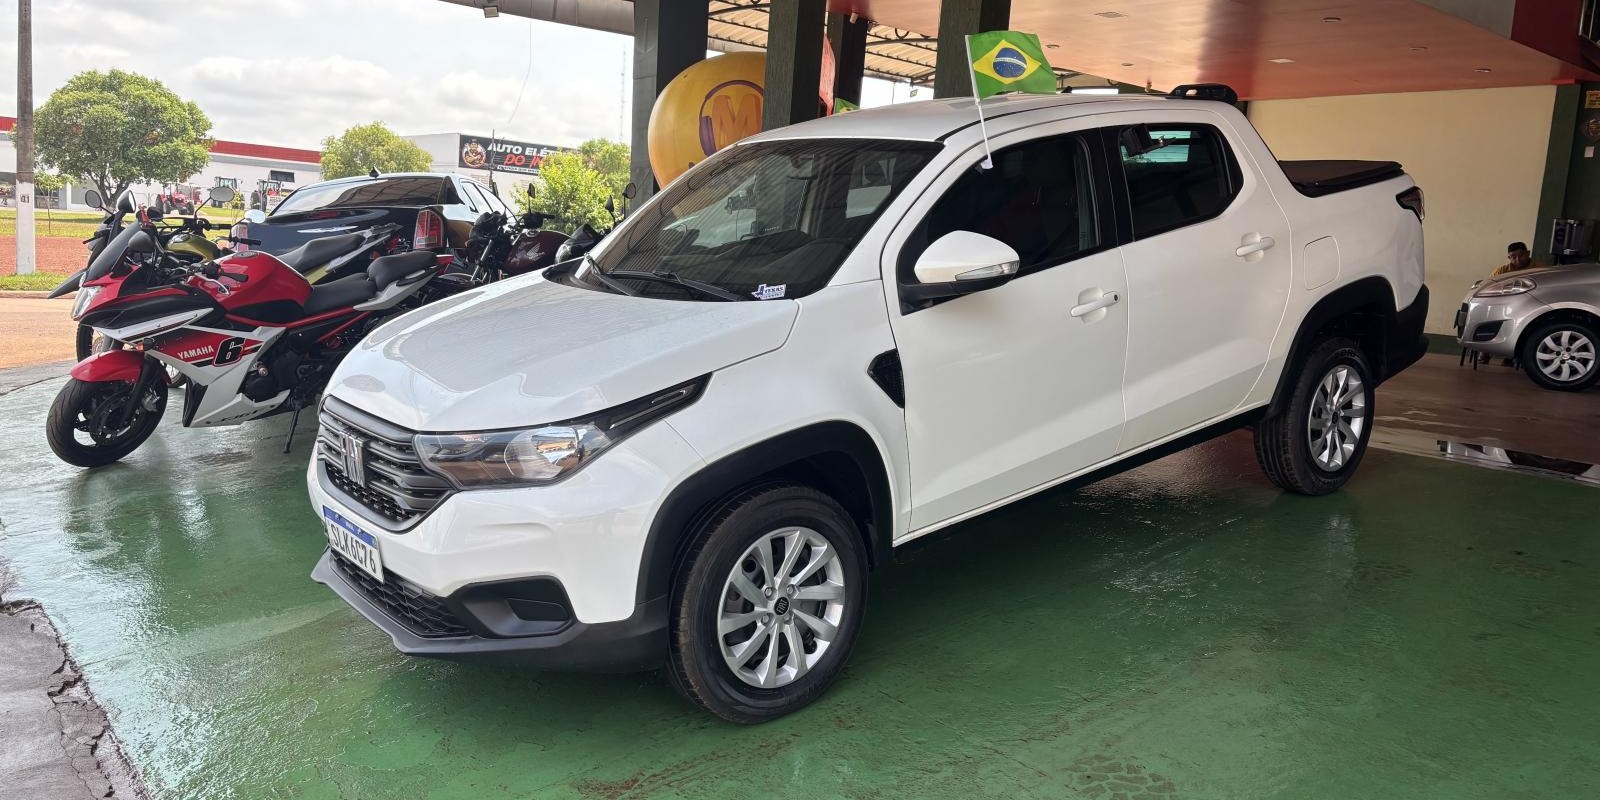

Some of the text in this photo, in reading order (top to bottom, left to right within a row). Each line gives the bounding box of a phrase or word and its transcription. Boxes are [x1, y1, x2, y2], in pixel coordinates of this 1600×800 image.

[487, 143, 522, 154] AUTO
[504, 153, 526, 166] DO
[177, 345, 214, 360] YAMAHA
[212, 336, 247, 367] 6
[331, 524, 376, 574] SLK6C76
[776, 599, 787, 613] FIAT
